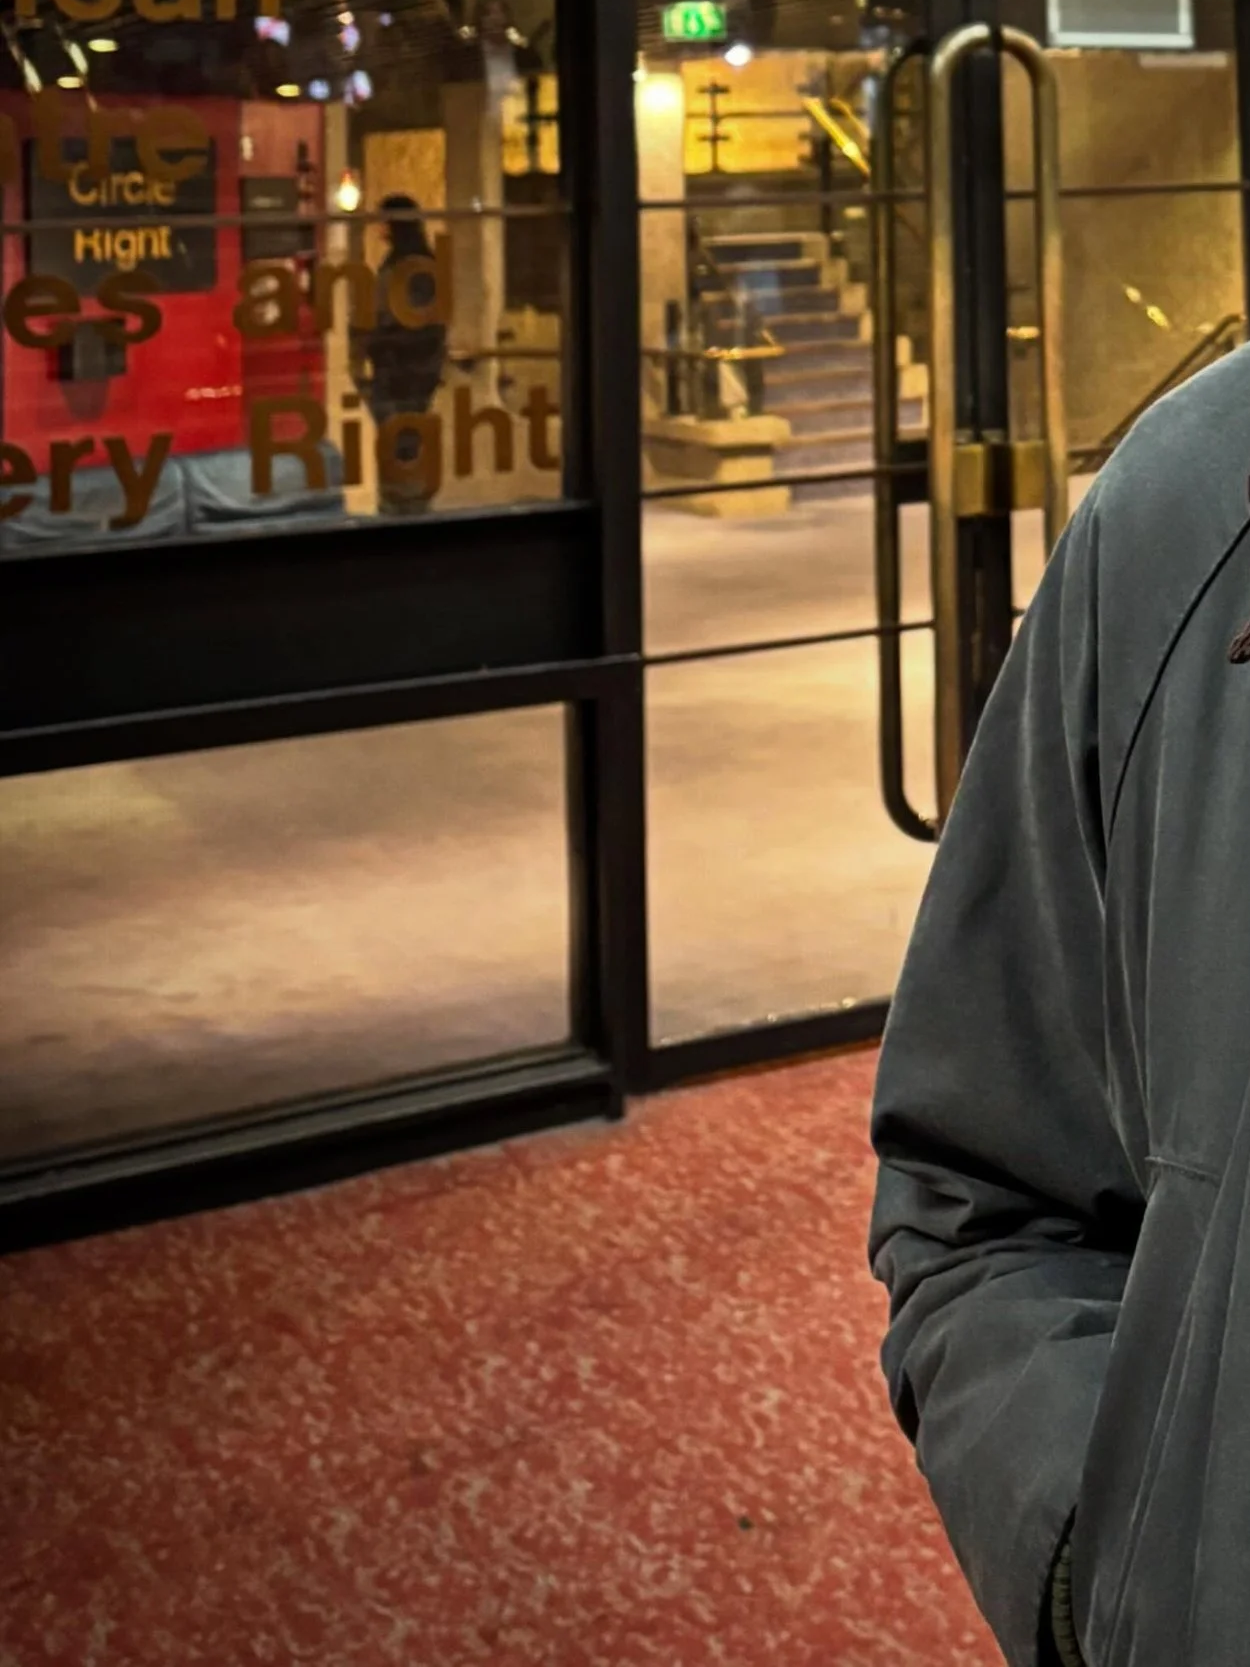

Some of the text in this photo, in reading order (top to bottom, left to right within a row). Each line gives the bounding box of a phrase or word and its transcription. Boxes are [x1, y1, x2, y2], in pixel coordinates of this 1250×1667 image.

[0, 89, 209, 184] tre
[233, 234, 454, 338] and
[250, 385, 562, 501] Right
